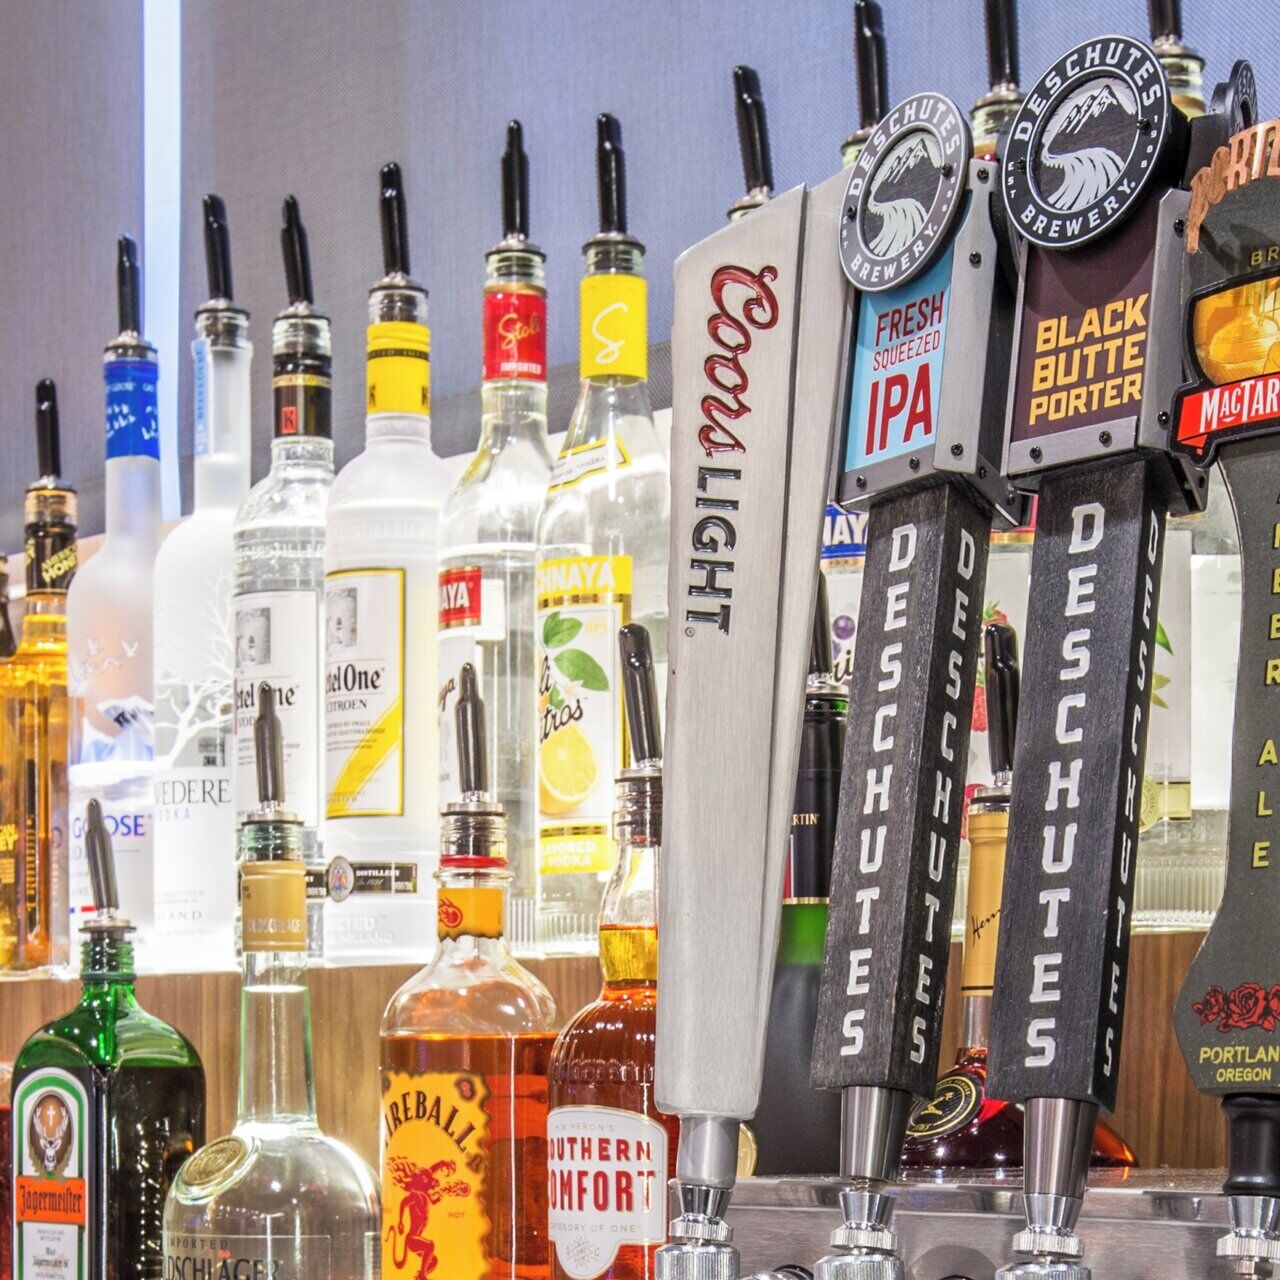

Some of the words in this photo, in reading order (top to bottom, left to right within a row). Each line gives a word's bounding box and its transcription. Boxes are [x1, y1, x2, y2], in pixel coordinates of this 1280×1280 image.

[1014, 41, 1162, 142] DESCHUTES
[848, 97, 961, 196] DESCHUTES
[873, 329, 941, 372] SQUEEZED
[875, 291, 945, 347] FRESH
[1035, 293, 1150, 353] BLACK
[698, 264, 780, 459] Coors
[1031, 331, 1147, 392] BUTTE
[865, 362, 932, 456] IPA
[1028, 372, 1143, 426] PORTER
[685, 465, 743, 636] LIGHT
[343, 663, 381, 692] One
[840, 522, 917, 1057] DESCHUTES
[910, 527, 976, 1066] DESCHUTES
[1024, 503, 1106, 1069] DESCHUTES
[1101, 508, 1160, 1078] DESCHUTES
[1250, 739, 1278, 869] ALE
[1215, 1066, 1272, 1083] OREGON
[385, 1089, 477, 1153] IREBALL
[549, 1136, 653, 1162] OUTHERN
[549, 1169, 657, 1213] OMFORT
[590, 1224, 605, 1233] OF
[610, 1224, 637, 1233] ONE
